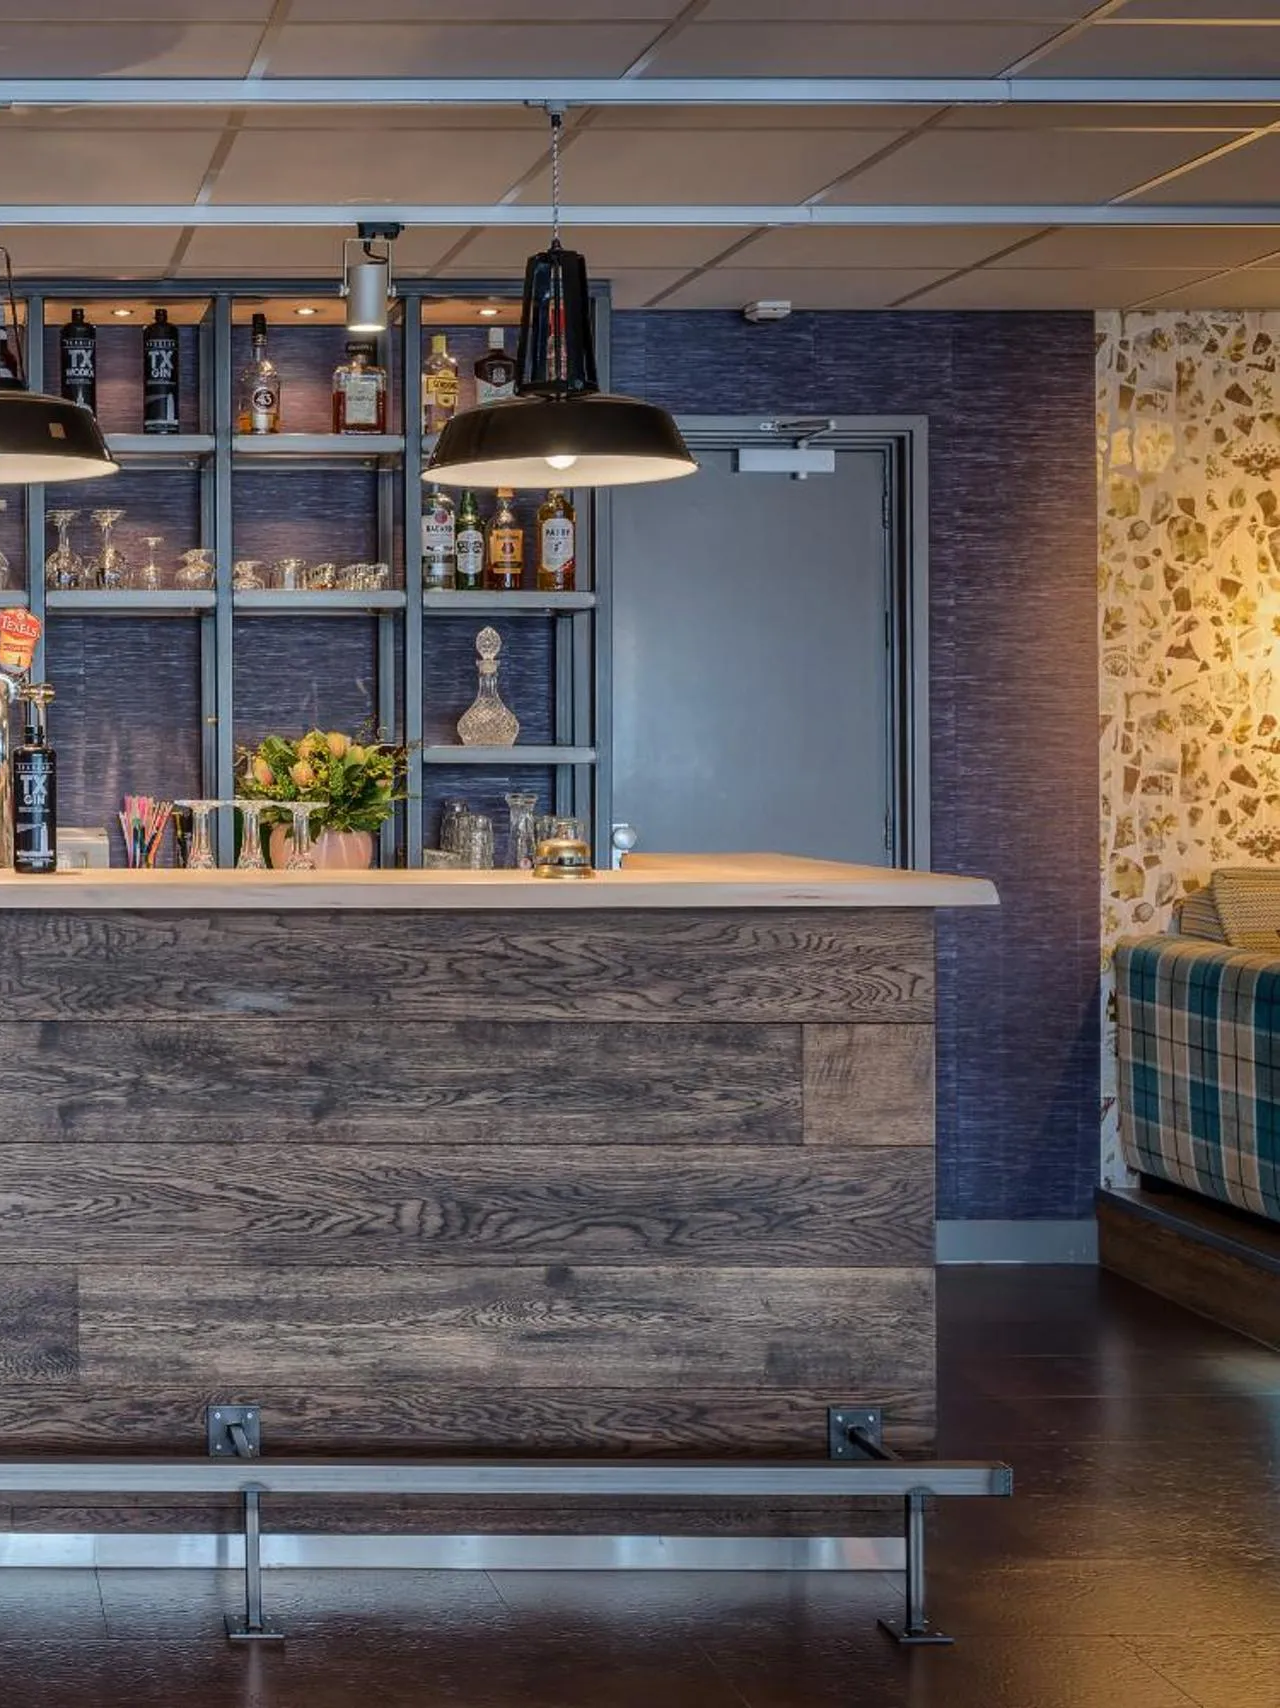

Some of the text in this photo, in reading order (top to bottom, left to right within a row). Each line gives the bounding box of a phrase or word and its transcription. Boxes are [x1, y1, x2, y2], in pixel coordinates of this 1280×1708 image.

[68, 349, 93, 368] TX
[148, 351, 174, 369] TX
[151, 368, 172, 378] GIN
[0, 615, 38, 637] TEXELS
[20, 774, 47, 795] TX
[24, 794, 45, 804] GIN
